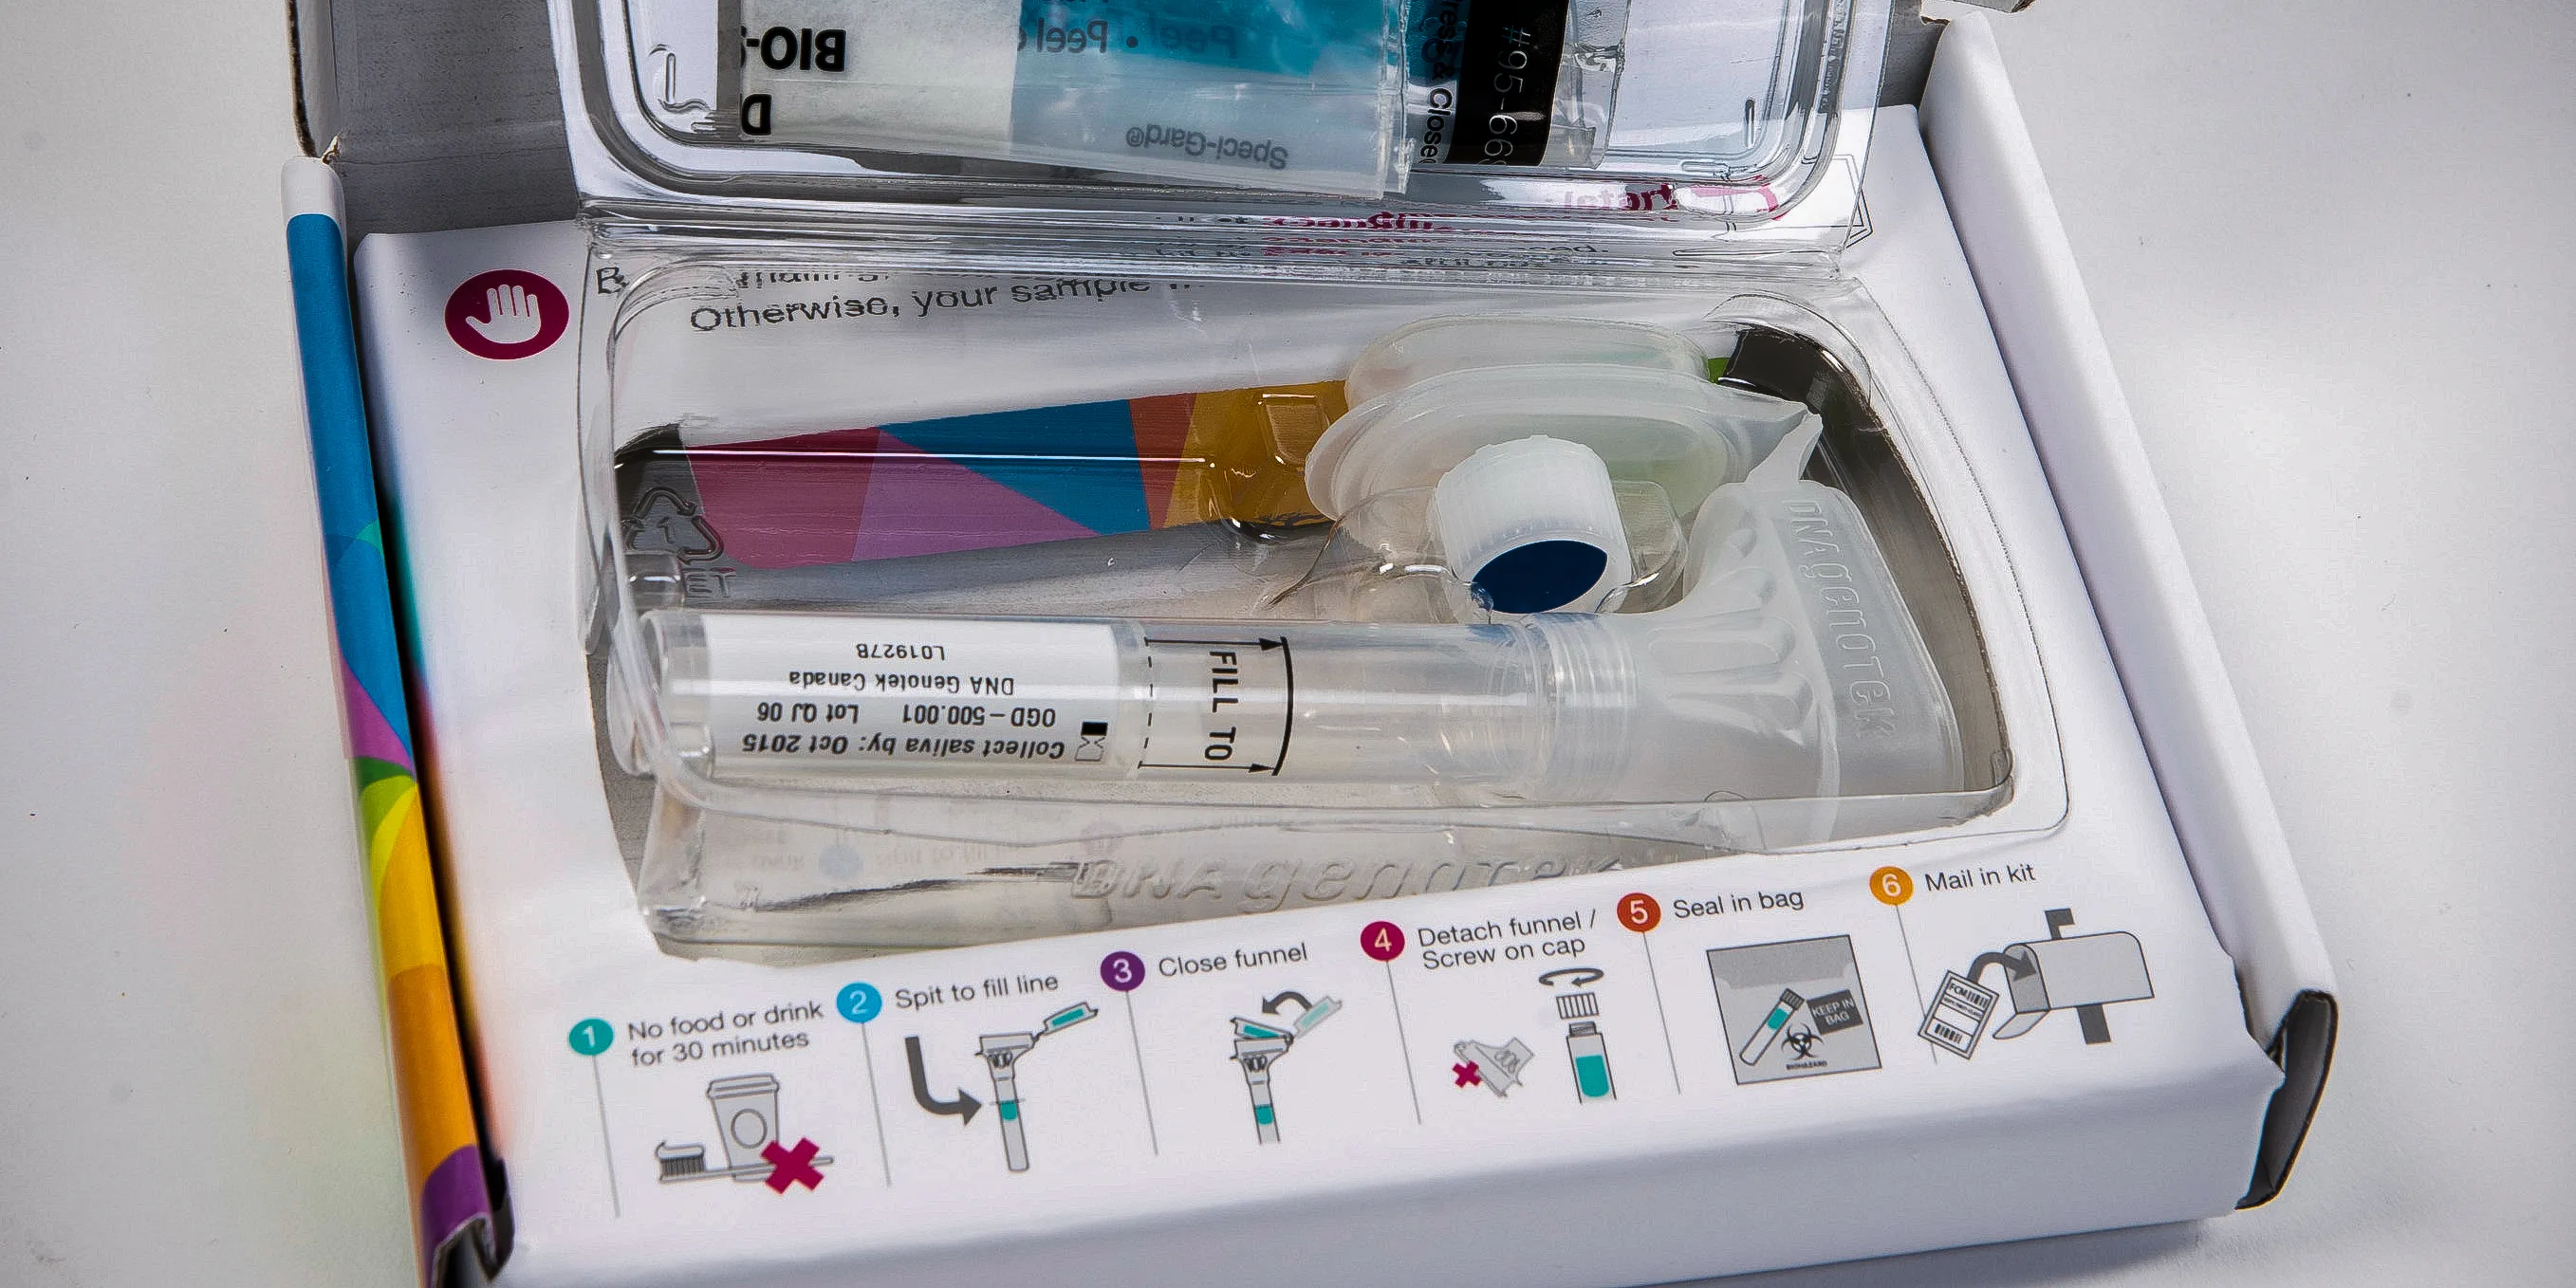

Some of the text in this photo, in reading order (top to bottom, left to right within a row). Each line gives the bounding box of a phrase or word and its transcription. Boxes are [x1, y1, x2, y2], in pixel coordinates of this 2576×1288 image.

[1436, 0, 1463, 52] ress
[740, 25, 847, 72] BIO-
[691, 294, 900, 332] Otherwise,
[912, 285, 998, 317] your
[789, 672, 1014, 695] DNA Genotek Canada
[757, 702, 783, 722] 06
[825, 704, 859, 725] Lot
[1205, 648, 1242, 761] FILL TO
[742, 732, 1065, 761] Collect saliva by: Oct 2015
[1881, 873, 1901, 897] 6
[1925, 864, 2036, 892] Mail in kit
[1630, 899, 1649, 925] 5
[1674, 892, 1804, 918] Seal in bag
[1374, 928, 1392, 952] 4
[1418, 920, 1503, 946] Detach
[1509, 912, 1581, 937] funnel
[1158, 942, 1307, 977] Close funnel
[1422, 939, 1585, 969] Screw on cap
[1113, 958, 1133, 984] 3
[849, 990, 867, 1015] 2
[896, 975, 1058, 1011] Spit to fill line
[628, 1001, 824, 1040] No food or drink
[1811, 997, 1856, 1018] KEEP IN
[1825, 1011, 1850, 1025] BAG
[584, 1025, 595, 1046] 1
[630, 1031, 809, 1067] for 30 minutes
